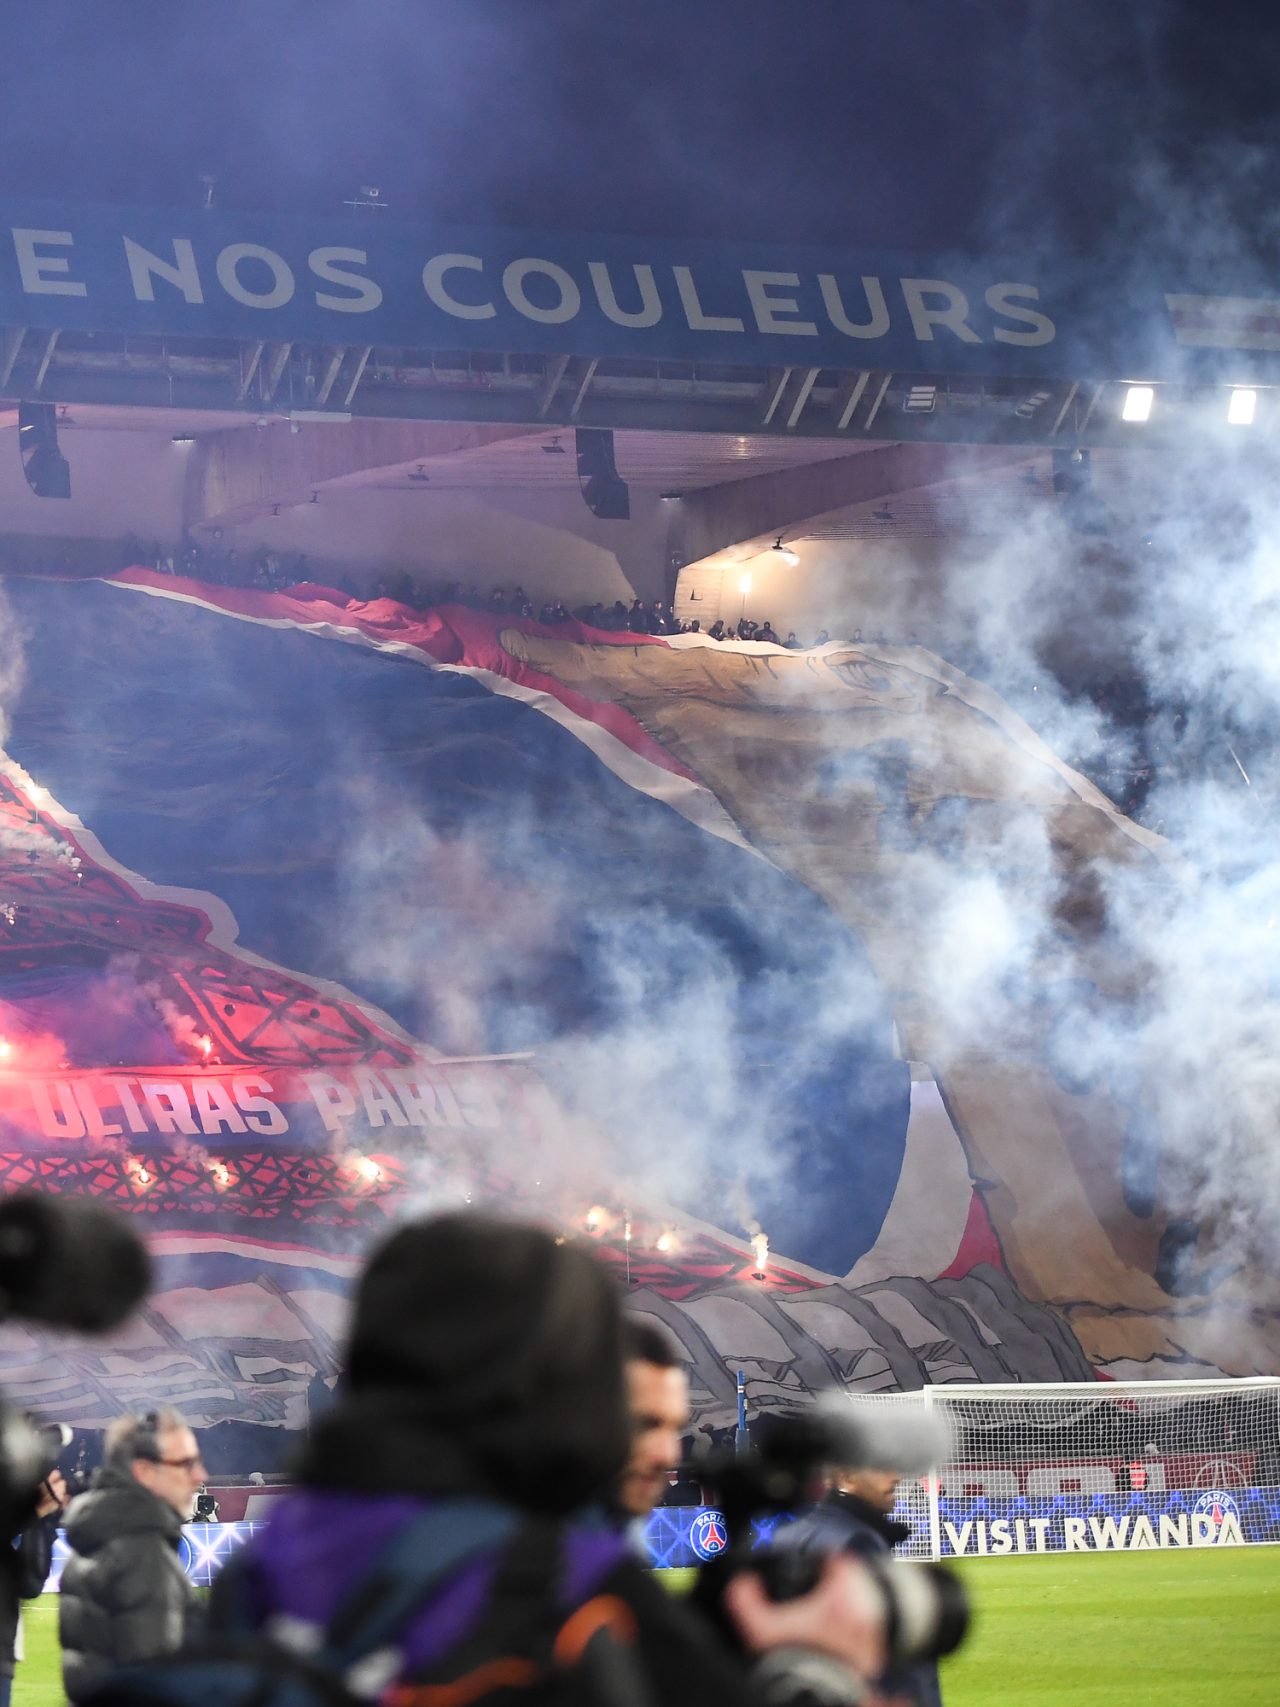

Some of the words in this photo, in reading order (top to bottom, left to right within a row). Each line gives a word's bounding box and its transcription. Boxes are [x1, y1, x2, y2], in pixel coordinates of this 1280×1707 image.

[122, 235, 383, 313] NOS
[422, 253, 1056, 347] COULEURS
[30, 1074, 289, 1138] ULTRAS
[302, 1067, 500, 1131] PARIS
[696, 1513, 726, 1527] PARIS
[1200, 1493, 1231, 1508] PARIS
[944, 1517, 1051, 1556] VISIT
[1064, 1512, 1245, 1551] RWANDA
